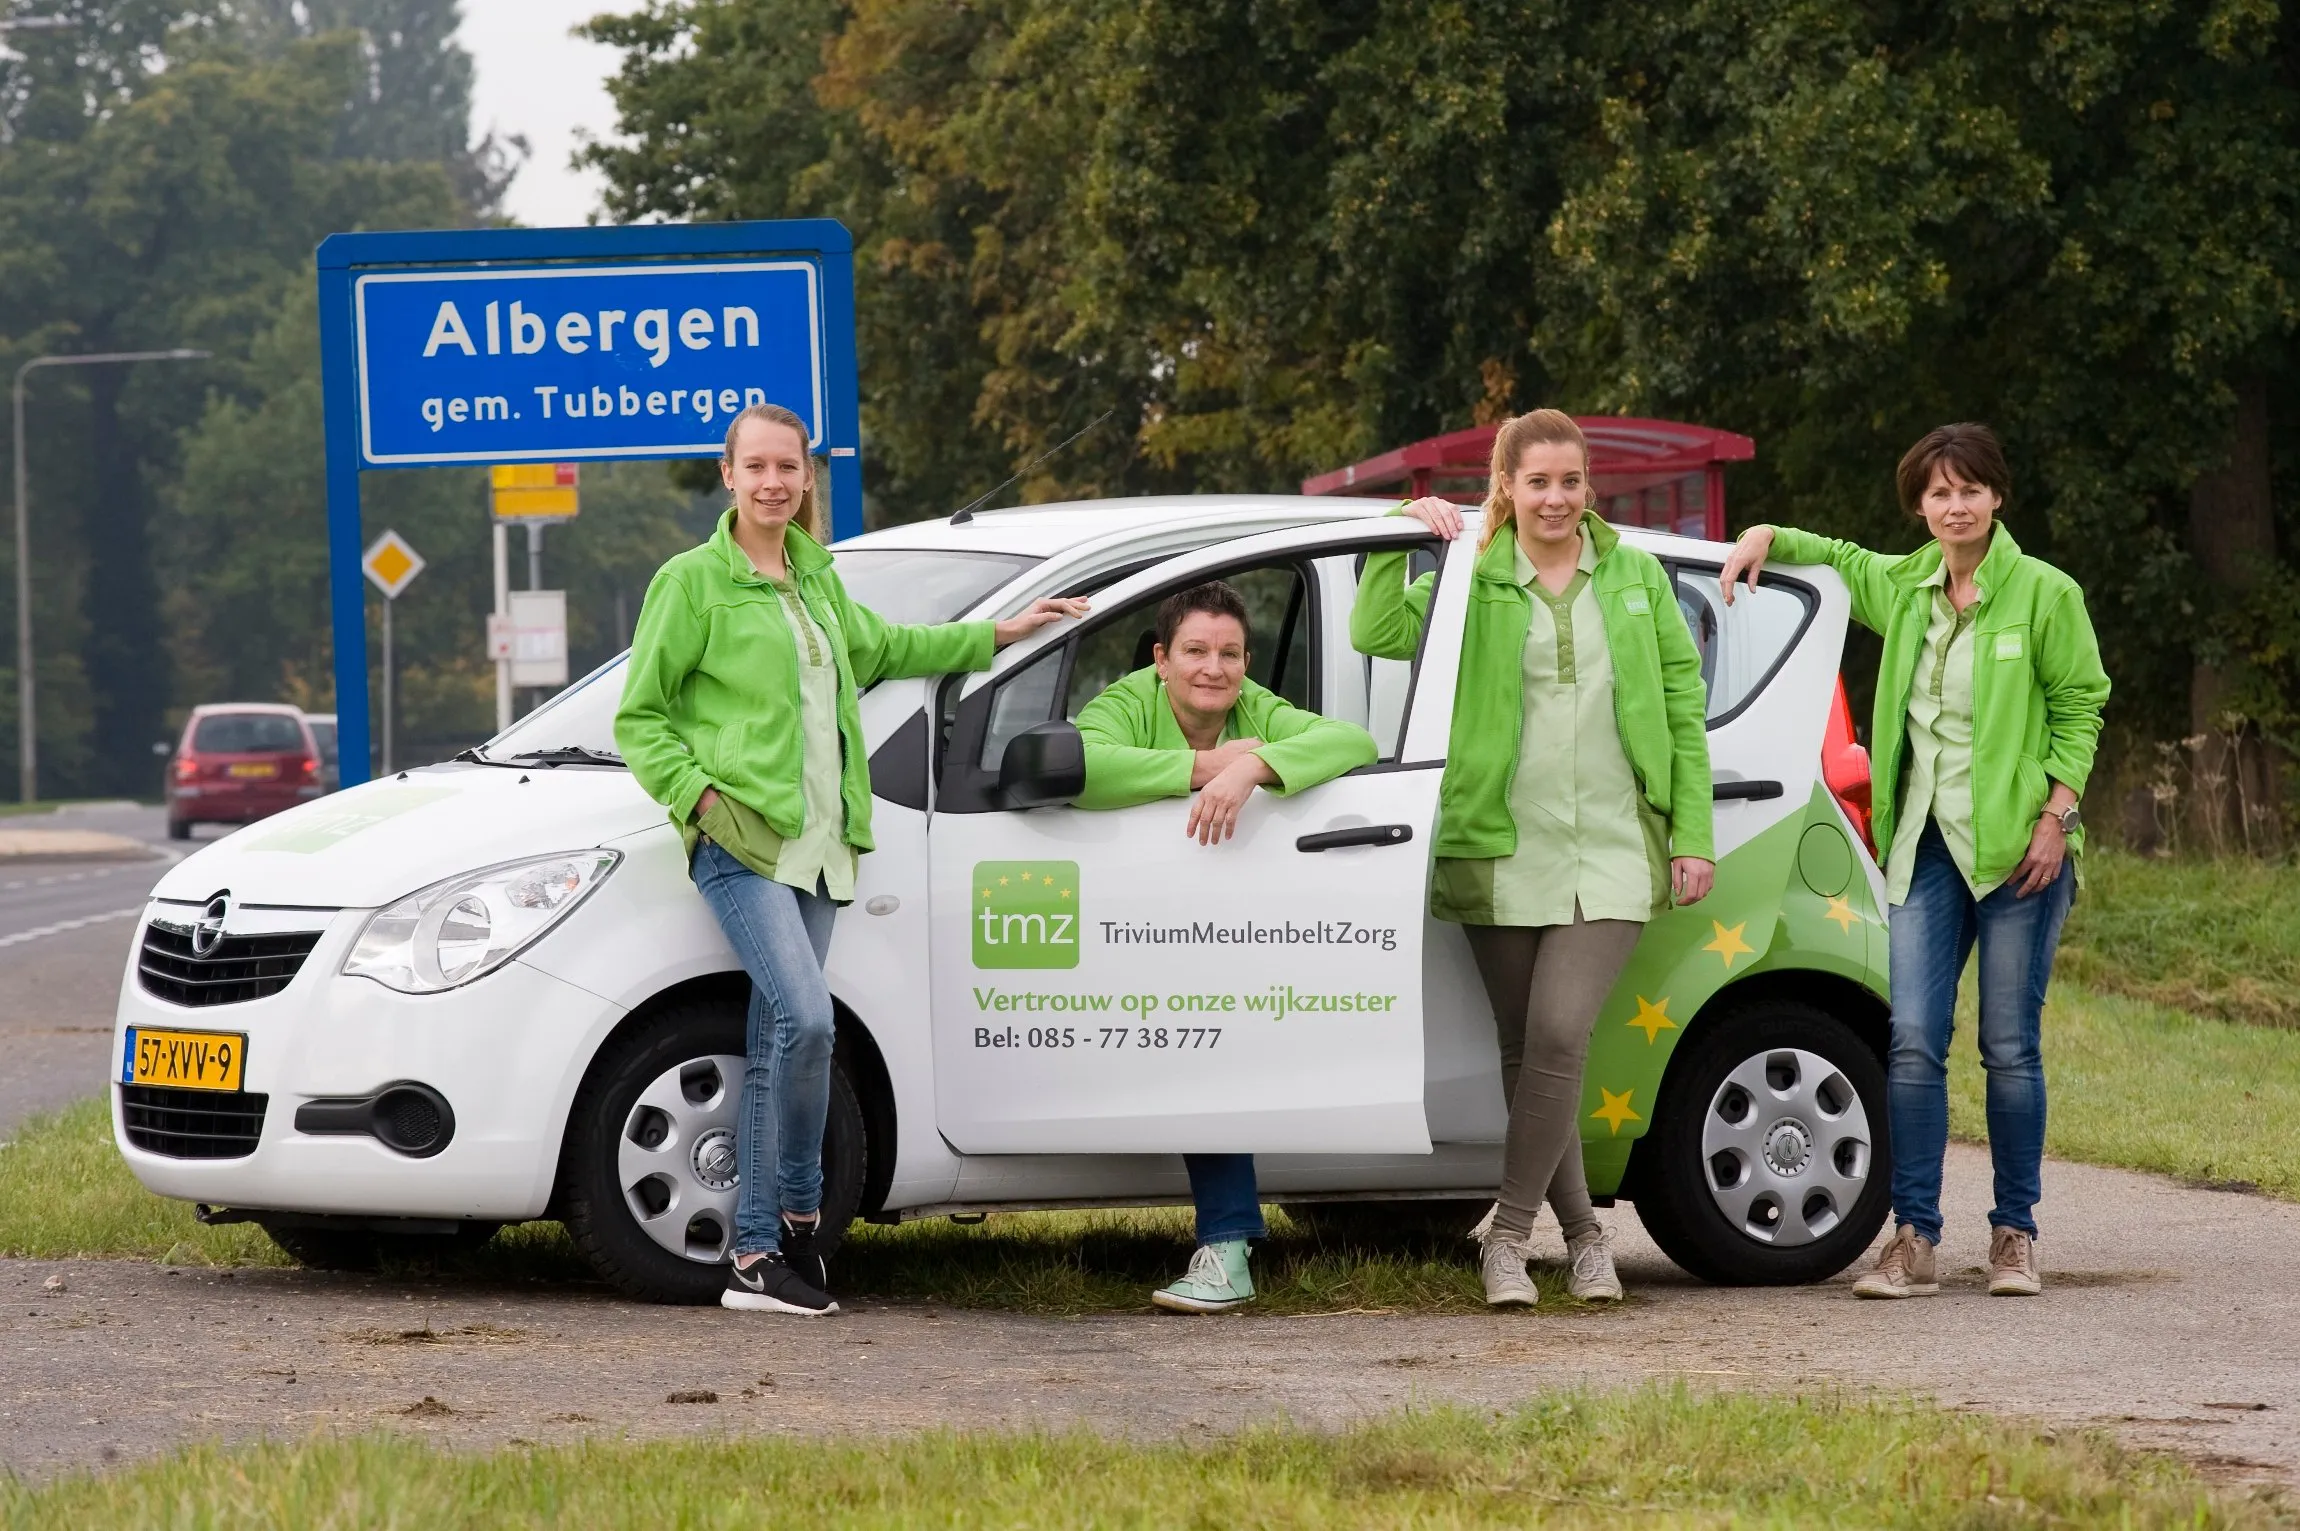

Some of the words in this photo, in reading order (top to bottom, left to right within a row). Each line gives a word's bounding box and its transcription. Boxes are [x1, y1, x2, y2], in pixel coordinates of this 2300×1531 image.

[422, 299, 760, 368] Albergen
[421, 395, 521, 433] gem.
[534, 383, 767, 424] Tubbergen
[979, 906, 1074, 946] tmz
[1099, 920, 1398, 951] TriviumMeulenbeltZorg
[972, 987, 1113, 1012] Vertrouw
[1120, 993, 1160, 1020] op
[1166, 994, 1236, 1012] onze
[1244, 984, 1397, 1021] wijkzuster
[974, 1026, 1020, 1049] Bel:
[1027, 1027, 1075, 1049] 085
[1099, 1028, 1129, 1049] 77
[1137, 1027, 1169, 1049] 38
[1176, 1028, 1222, 1049] 777
